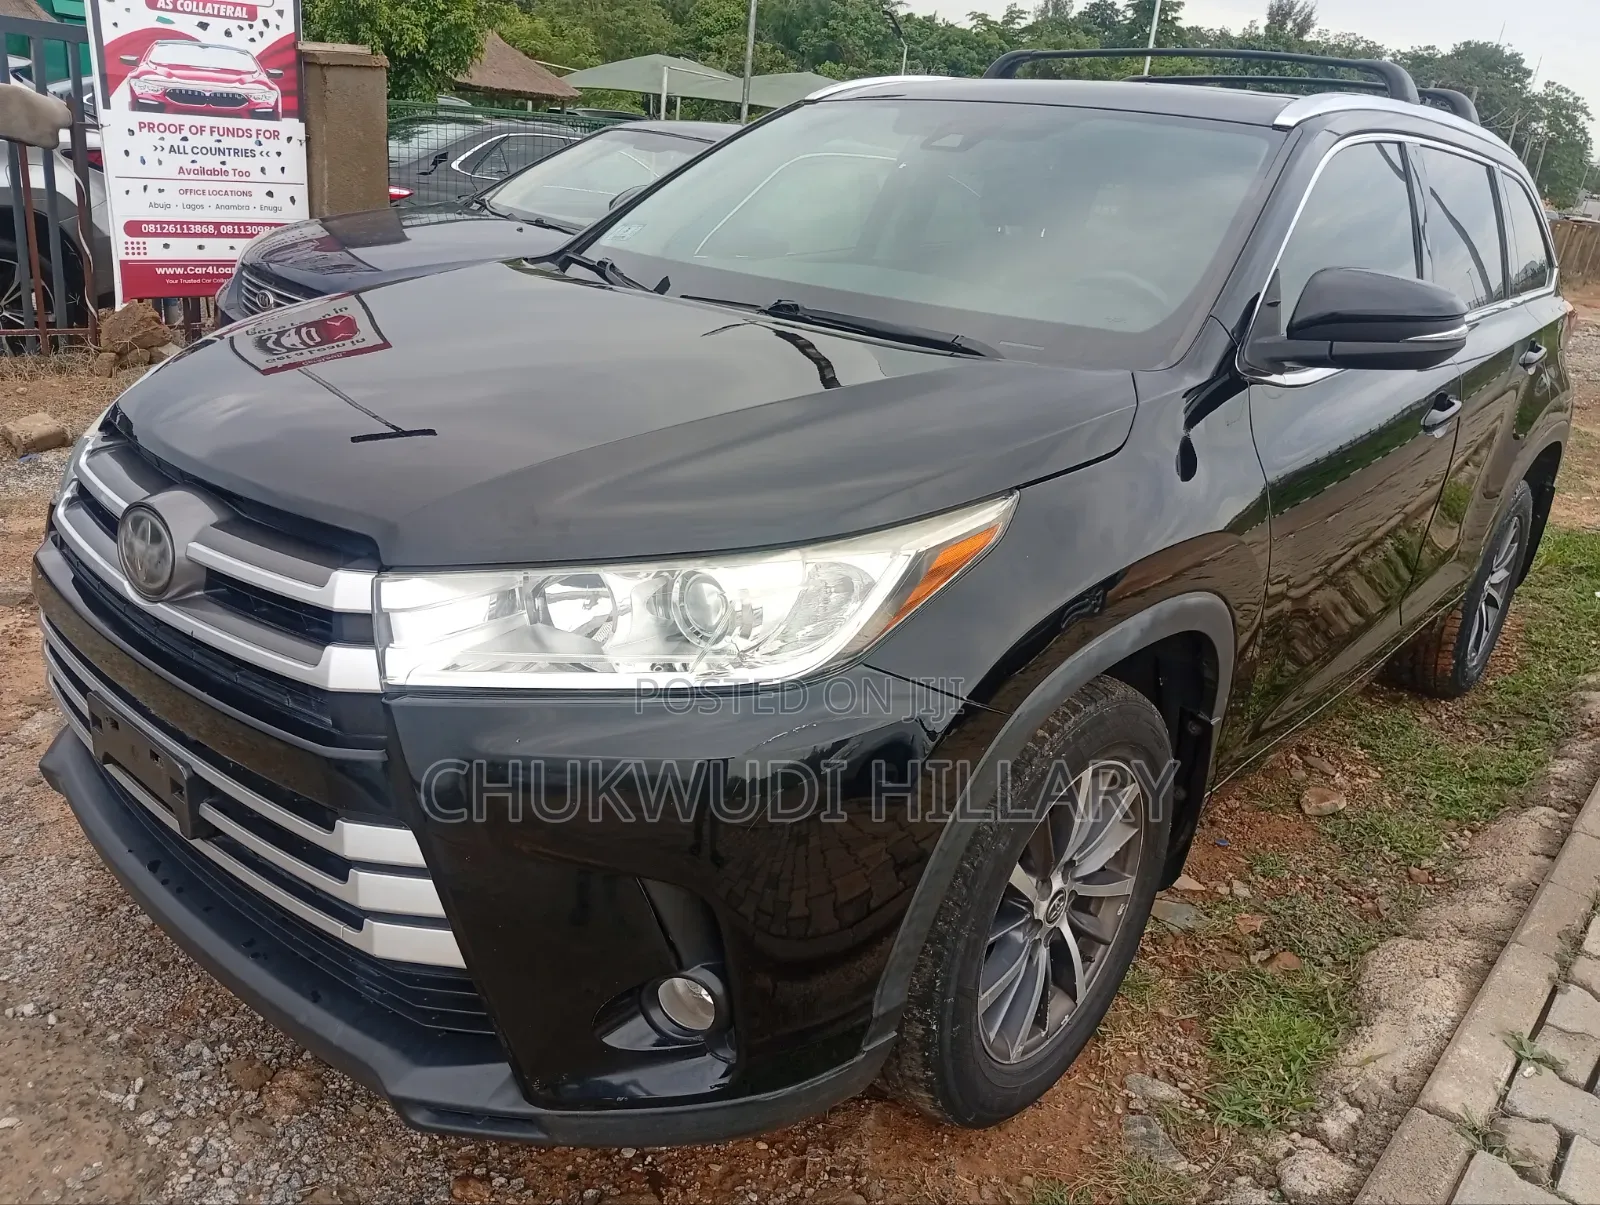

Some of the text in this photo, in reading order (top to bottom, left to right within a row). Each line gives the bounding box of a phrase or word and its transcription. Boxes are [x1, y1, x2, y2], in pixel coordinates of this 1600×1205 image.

[156, 0, 248, 18] AS COLLATERAL
[138, 122, 280, 140] PROOF OF FUNDS FOR
[168, 144, 256, 158] ALL COUNTRIES
[178, 166, 251, 178] Available Too
[178, 188, 253, 198] OFFICE LOCATIONS
[148, 201, 283, 213] Abuja Lagos Anambra Enugu
[141, 223, 218, 235] 08126113868,
